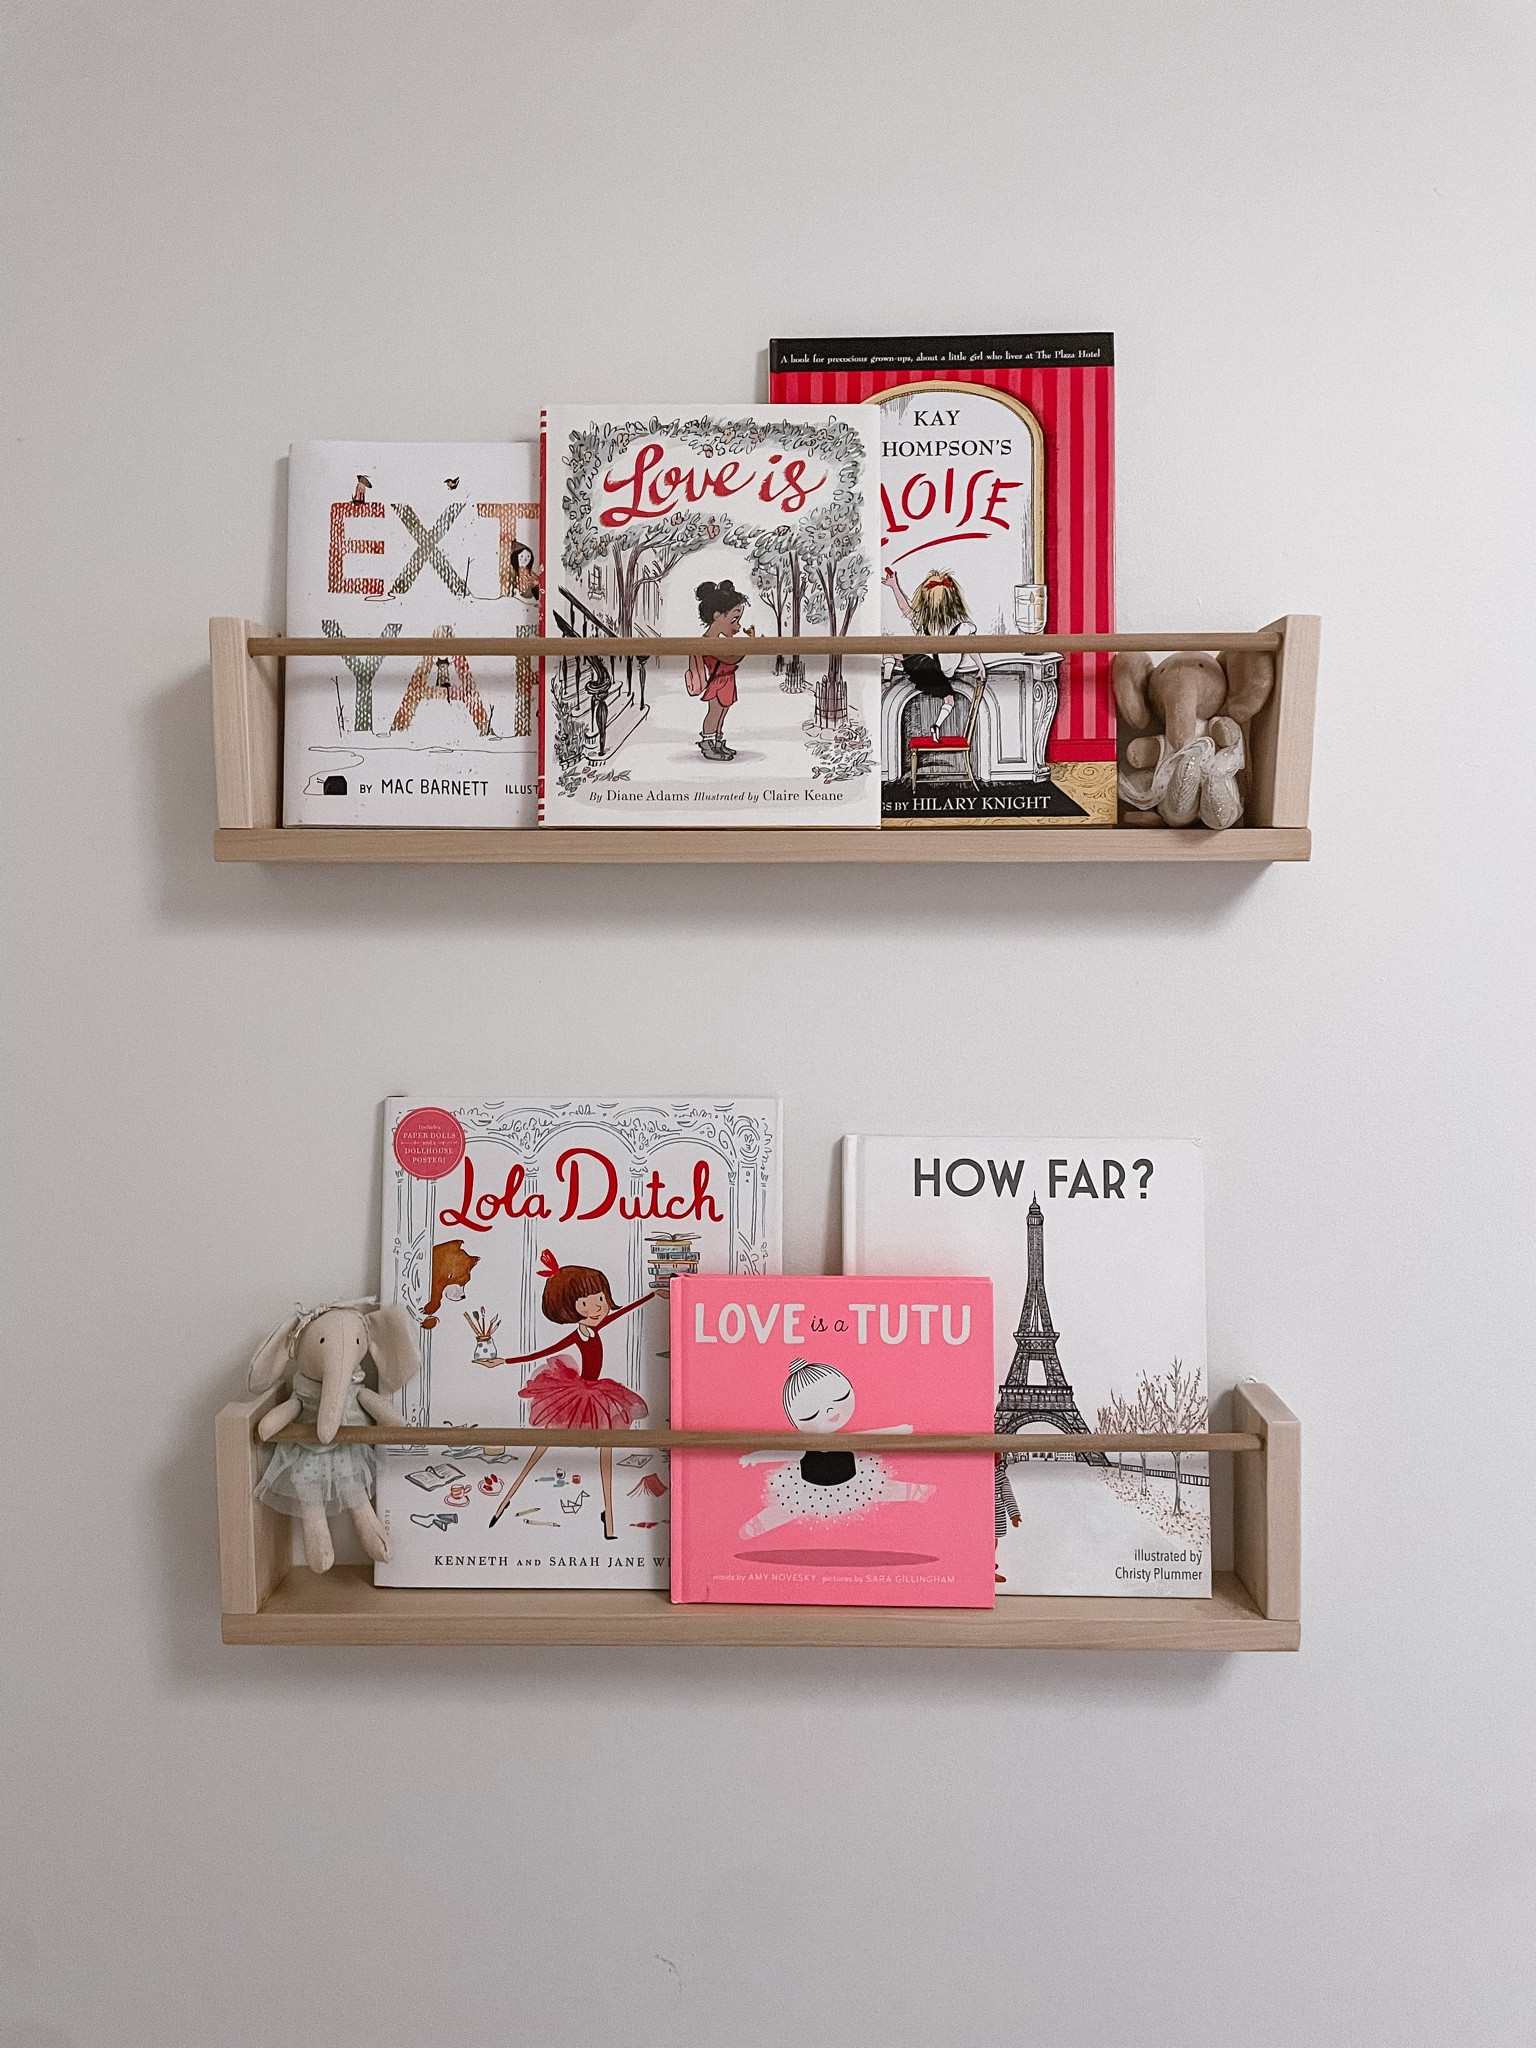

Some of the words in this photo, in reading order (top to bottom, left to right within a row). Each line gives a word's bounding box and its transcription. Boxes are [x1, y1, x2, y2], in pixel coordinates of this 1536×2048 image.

[781, 355, 788, 363] A
[790, 353, 810, 363] book
[813, 353, 825, 363] for
[827, 355, 868, 365] precocious
[870, 355, 914, 364] grown-ups,
[916, 352, 938, 362] about
[948, 352, 967, 361] little
[969, 351, 983, 362] girl
[986, 351, 1003, 360] who
[1005, 351, 1023, 360] lives
[1025, 351, 1033, 359] at
[1035, 350, 1052, 359] The
[1054, 350, 1076, 359] Plaza
[1078, 349, 1101, 358] Hotel
[913, 410, 960, 427] KAY
[599, 443, 757, 528] Love
[757, 454, 829, 513] is
[359, 784, 373, 794] BY
[381, 779, 414, 794] MAC
[420, 780, 489, 796] BARNETT
[589, 791, 603, 803] By
[606, 789, 643, 801] Diane
[646, 789, 690, 801] Adams
[693, 791, 745, 801] Illustrated
[747, 791, 759, 803] by
[763, 789, 800, 801] Claire
[804, 789, 843, 801] Keane
[894, 802, 909, 811] BY
[912, 797, 977, 811] HILARY
[981, 795, 1051, 810] KNIGHT
[404, 1147, 454, 1155] DOLLHOUSE
[914, 1158, 1025, 1197] HOW
[1049, 1158, 1154, 1199] FAR?
[439, 1156, 551, 1232] Lola
[556, 1147, 724, 1222] Dutch
[695, 1303, 805, 1344] LOVE
[810, 1315, 828, 1332] is
[833, 1320, 849, 1332] a
[848, 1304, 971, 1345] TUTU
[434, 1555, 508, 1566] KENNETH
[549, 1556, 600, 1567] SARAH
[607, 1557, 645, 1567] JANE
[1134, 1549, 1187, 1562] illustrated
[1189, 1550, 1203, 1565] by
[736, 1573, 746, 1583] by
[747, 1573, 769, 1581] AMY
[771, 1573, 817, 1582] NOVESKY
[821, 1575, 852, 1584] pictures
[854, 1575, 864, 1583] by
[865, 1575, 892, 1583] SARA
[895, 1575, 955, 1584] GILLINGHAM
[1115, 1566, 1152, 1583] Christy
[1153, 1567, 1203, 1581] Plummer
